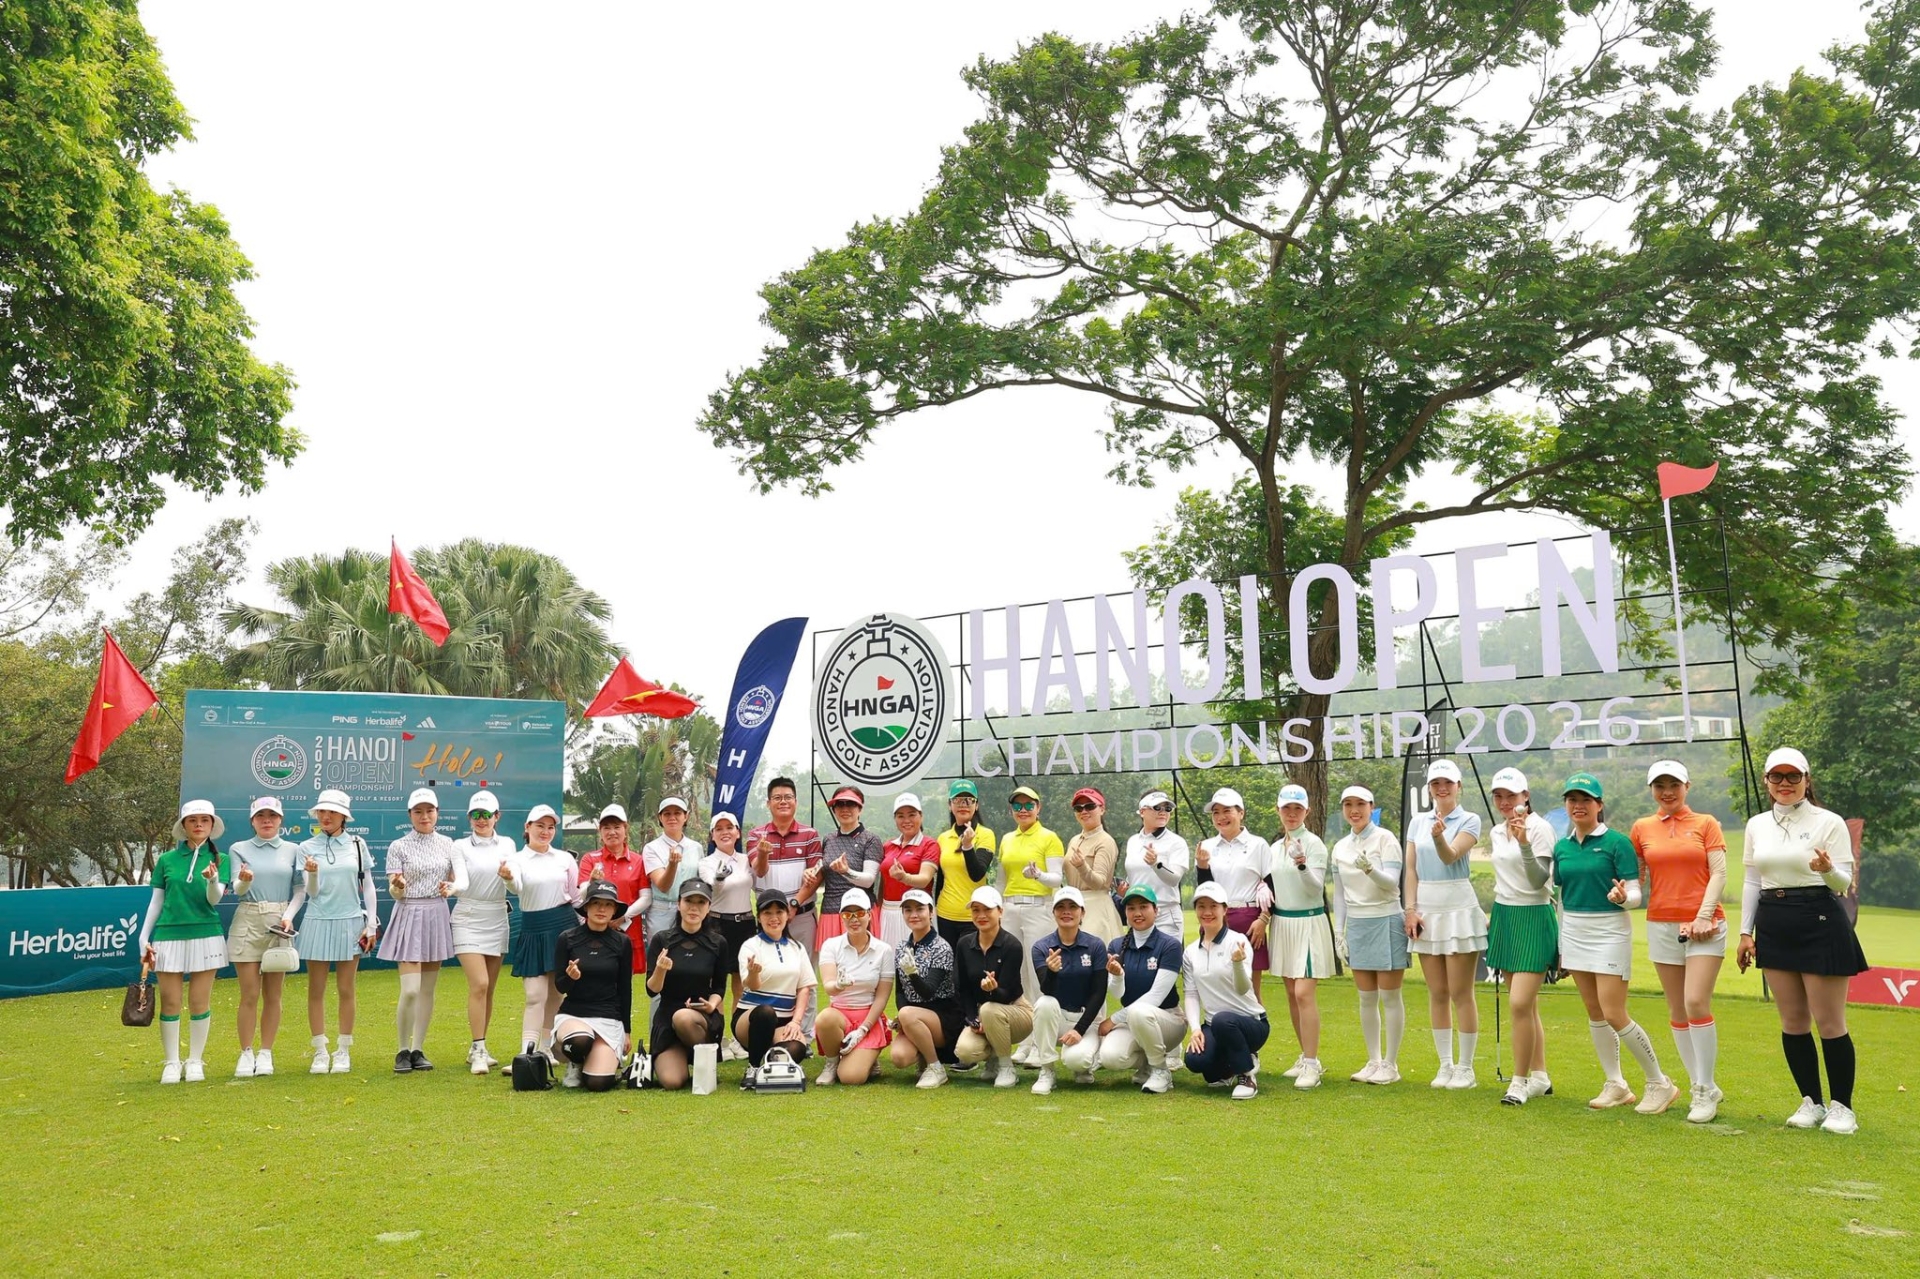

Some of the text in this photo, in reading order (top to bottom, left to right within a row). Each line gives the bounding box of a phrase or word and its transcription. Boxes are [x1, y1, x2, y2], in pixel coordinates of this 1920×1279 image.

[969, 530, 1619, 720] HANOI OPEN
[826, 658, 934, 772] HANOI GOLF ASSOCIATION
[844, 694, 915, 717] HNGA
[332, 715, 358, 724] PING
[365, 715, 403, 726] Herbalife
[1430, 723, 1441, 734] ET
[327, 736, 396, 761] HANOI
[972, 697, 1640, 778] CHAMPIONSHIP 2026
[263, 760, 295, 768] HNGA
[410, 743, 488, 778] Hole
[327, 762, 395, 784] OPEN
[326, 784, 394, 792] CHAMPIONSHIP
[9, 925, 127, 956] Herbalife
[73, 952, 86, 960] Live
